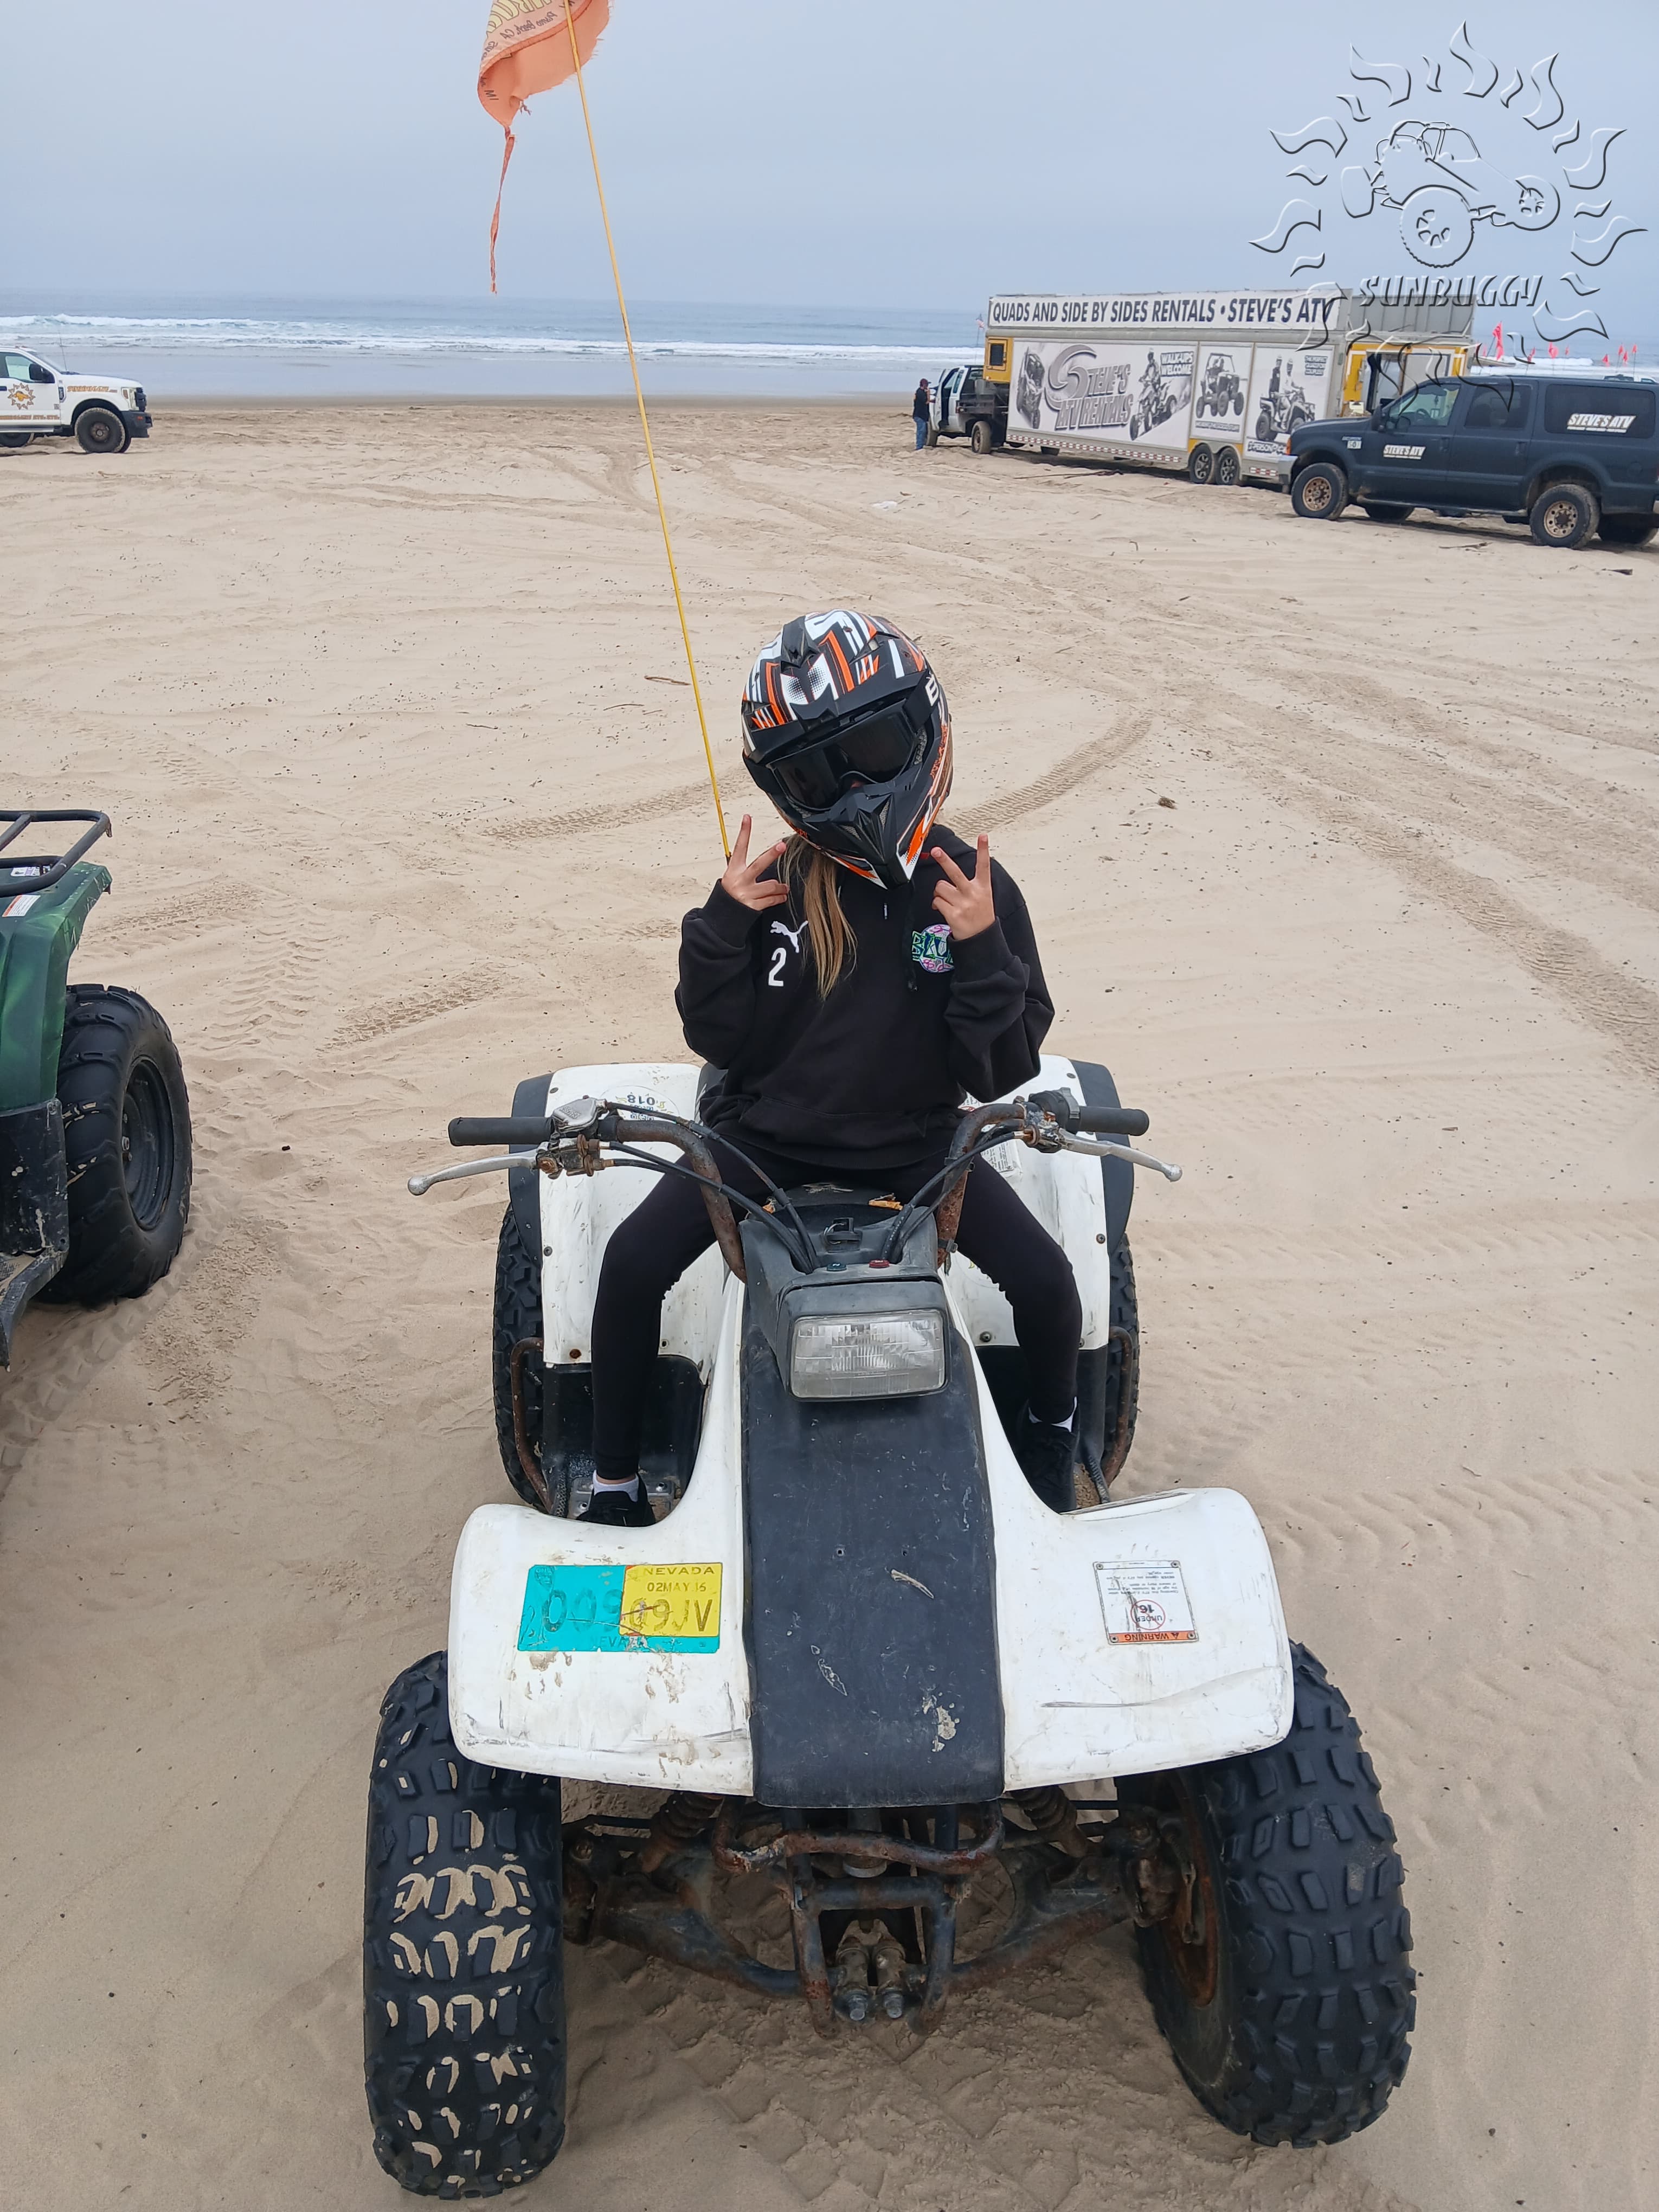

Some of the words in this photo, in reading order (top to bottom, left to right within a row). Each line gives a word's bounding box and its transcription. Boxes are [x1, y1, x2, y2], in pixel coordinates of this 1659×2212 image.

[993, 302, 1030, 323] QUADS
[1032, 302, 1058, 322] AND
[1061, 301, 1089, 323] SIDE
[1091, 301, 1109, 322] BY
[1110, 300, 1149, 323] SIDES
[1152, 299, 1216, 323] RENTALS
[1227, 298, 1293, 323] STEVE'S
[1296, 297, 1335, 323] ATV
[1160, 364, 1193, 377] WELCOME
[1054, 400, 1083, 431] ATV
[1078, 394, 1134, 429] RENTALS
[1609, 415, 1636, 429] ATV
[1409, 446, 1426, 456] ATV
[768, 947, 787, 987] 2
[627, 1094, 655, 1105] 018
[642, 1566, 715, 1576] NEVADA
[1139, 1604, 1154, 1613] 16
[1135, 1615, 1163, 1623] UNDER
[1124, 1632, 1169, 1641] WARNING
